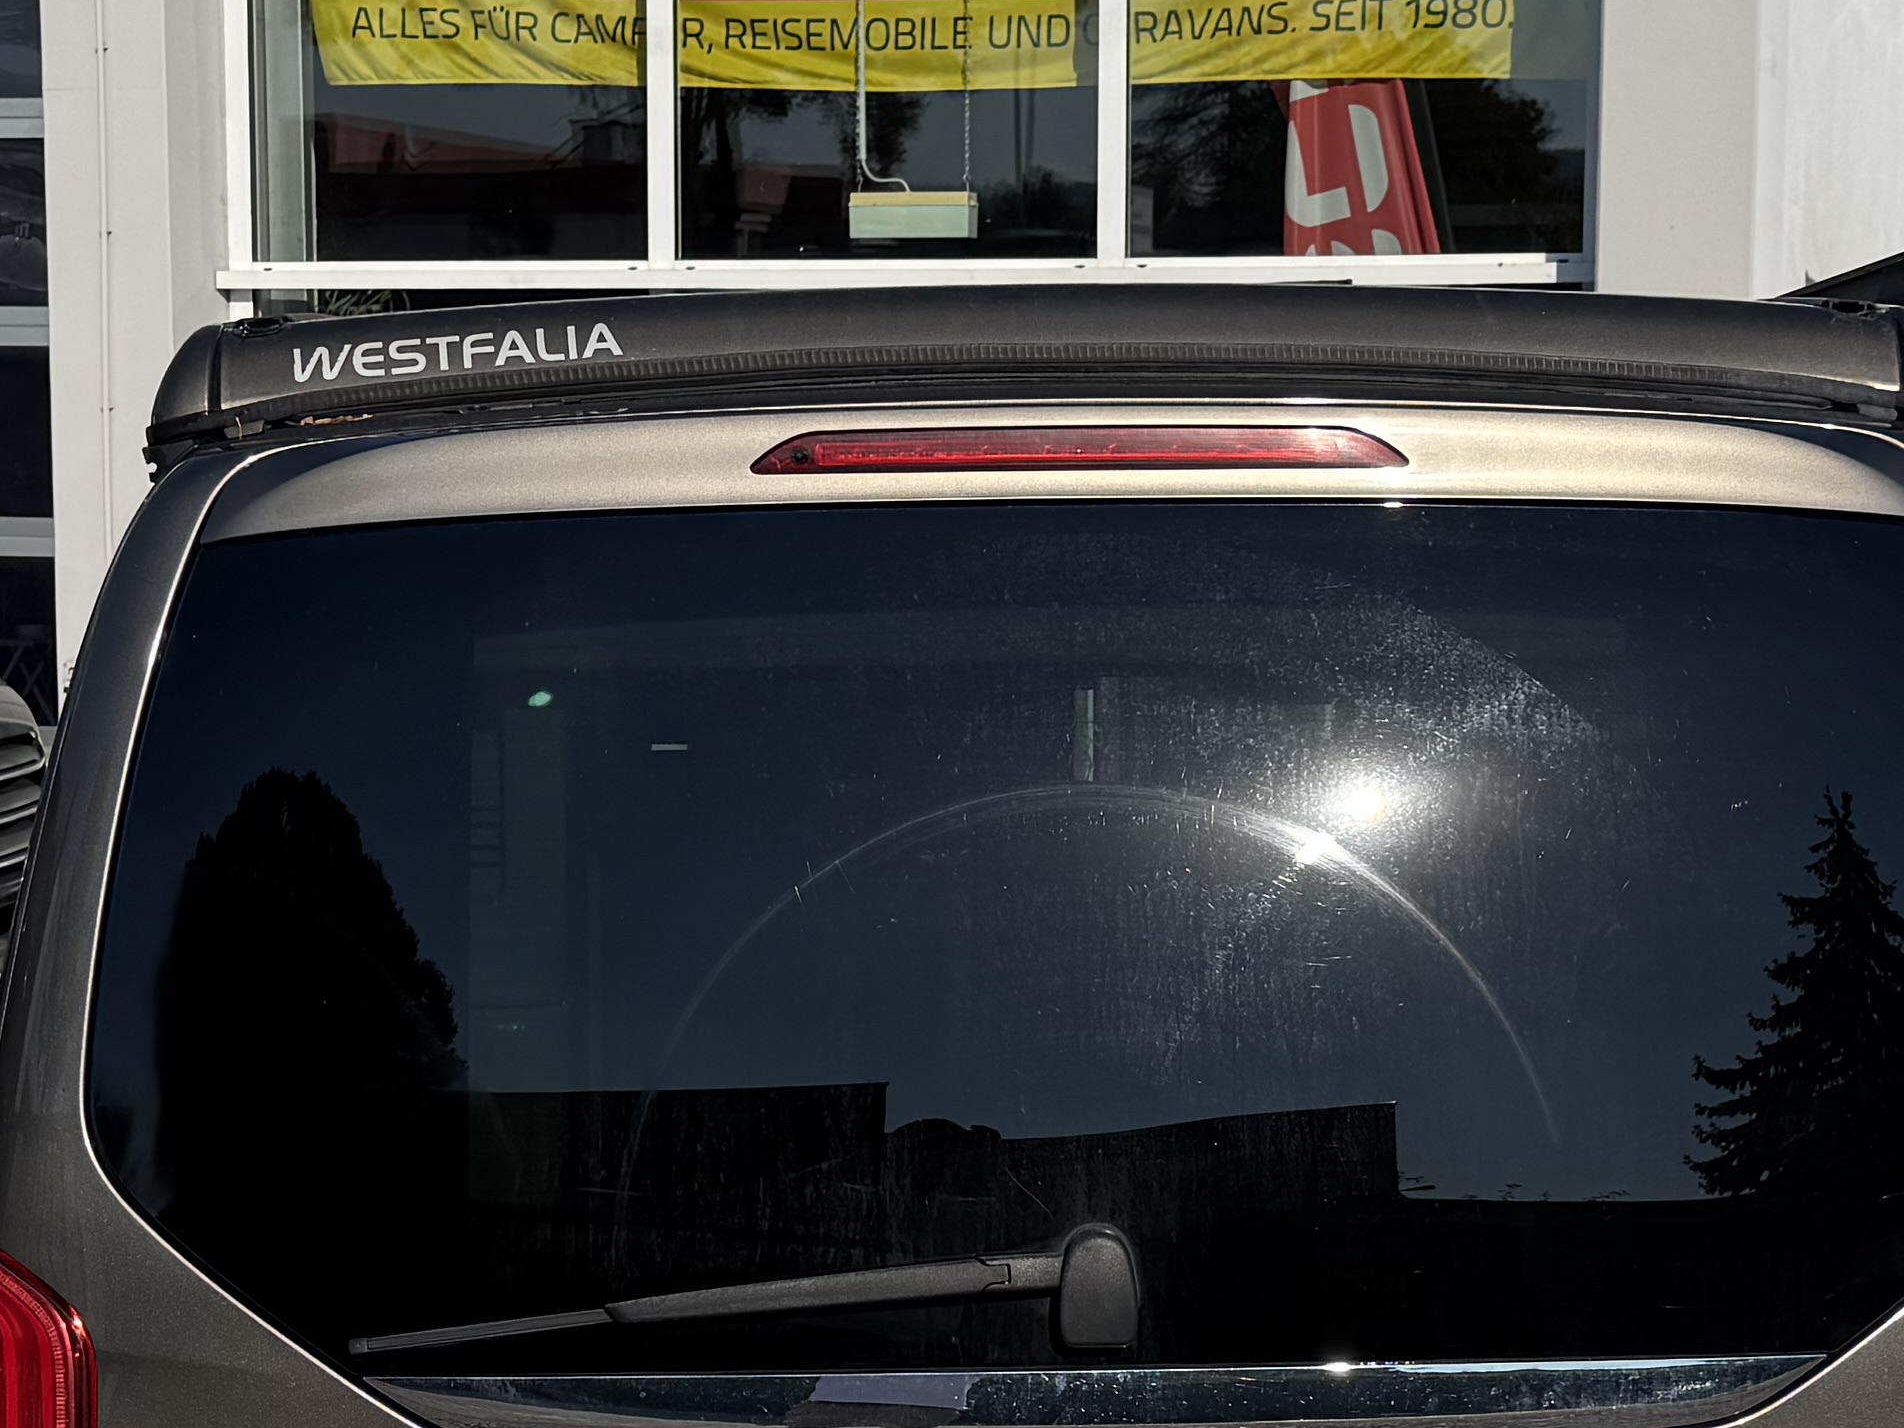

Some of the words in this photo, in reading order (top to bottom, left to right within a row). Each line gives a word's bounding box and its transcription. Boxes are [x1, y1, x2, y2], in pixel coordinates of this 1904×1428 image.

[351, 6, 460, 40] ALLES
[472, 5, 538, 43] FÜR
[550, 11, 713, 54] CAMPR,
[724, 15, 972, 51] REISEMOBILE
[988, 14, 1071, 49] UND
[1082, 1, 1297, 46] CRAVANS.
[292, 321, 624, 383] WESTFALIA
